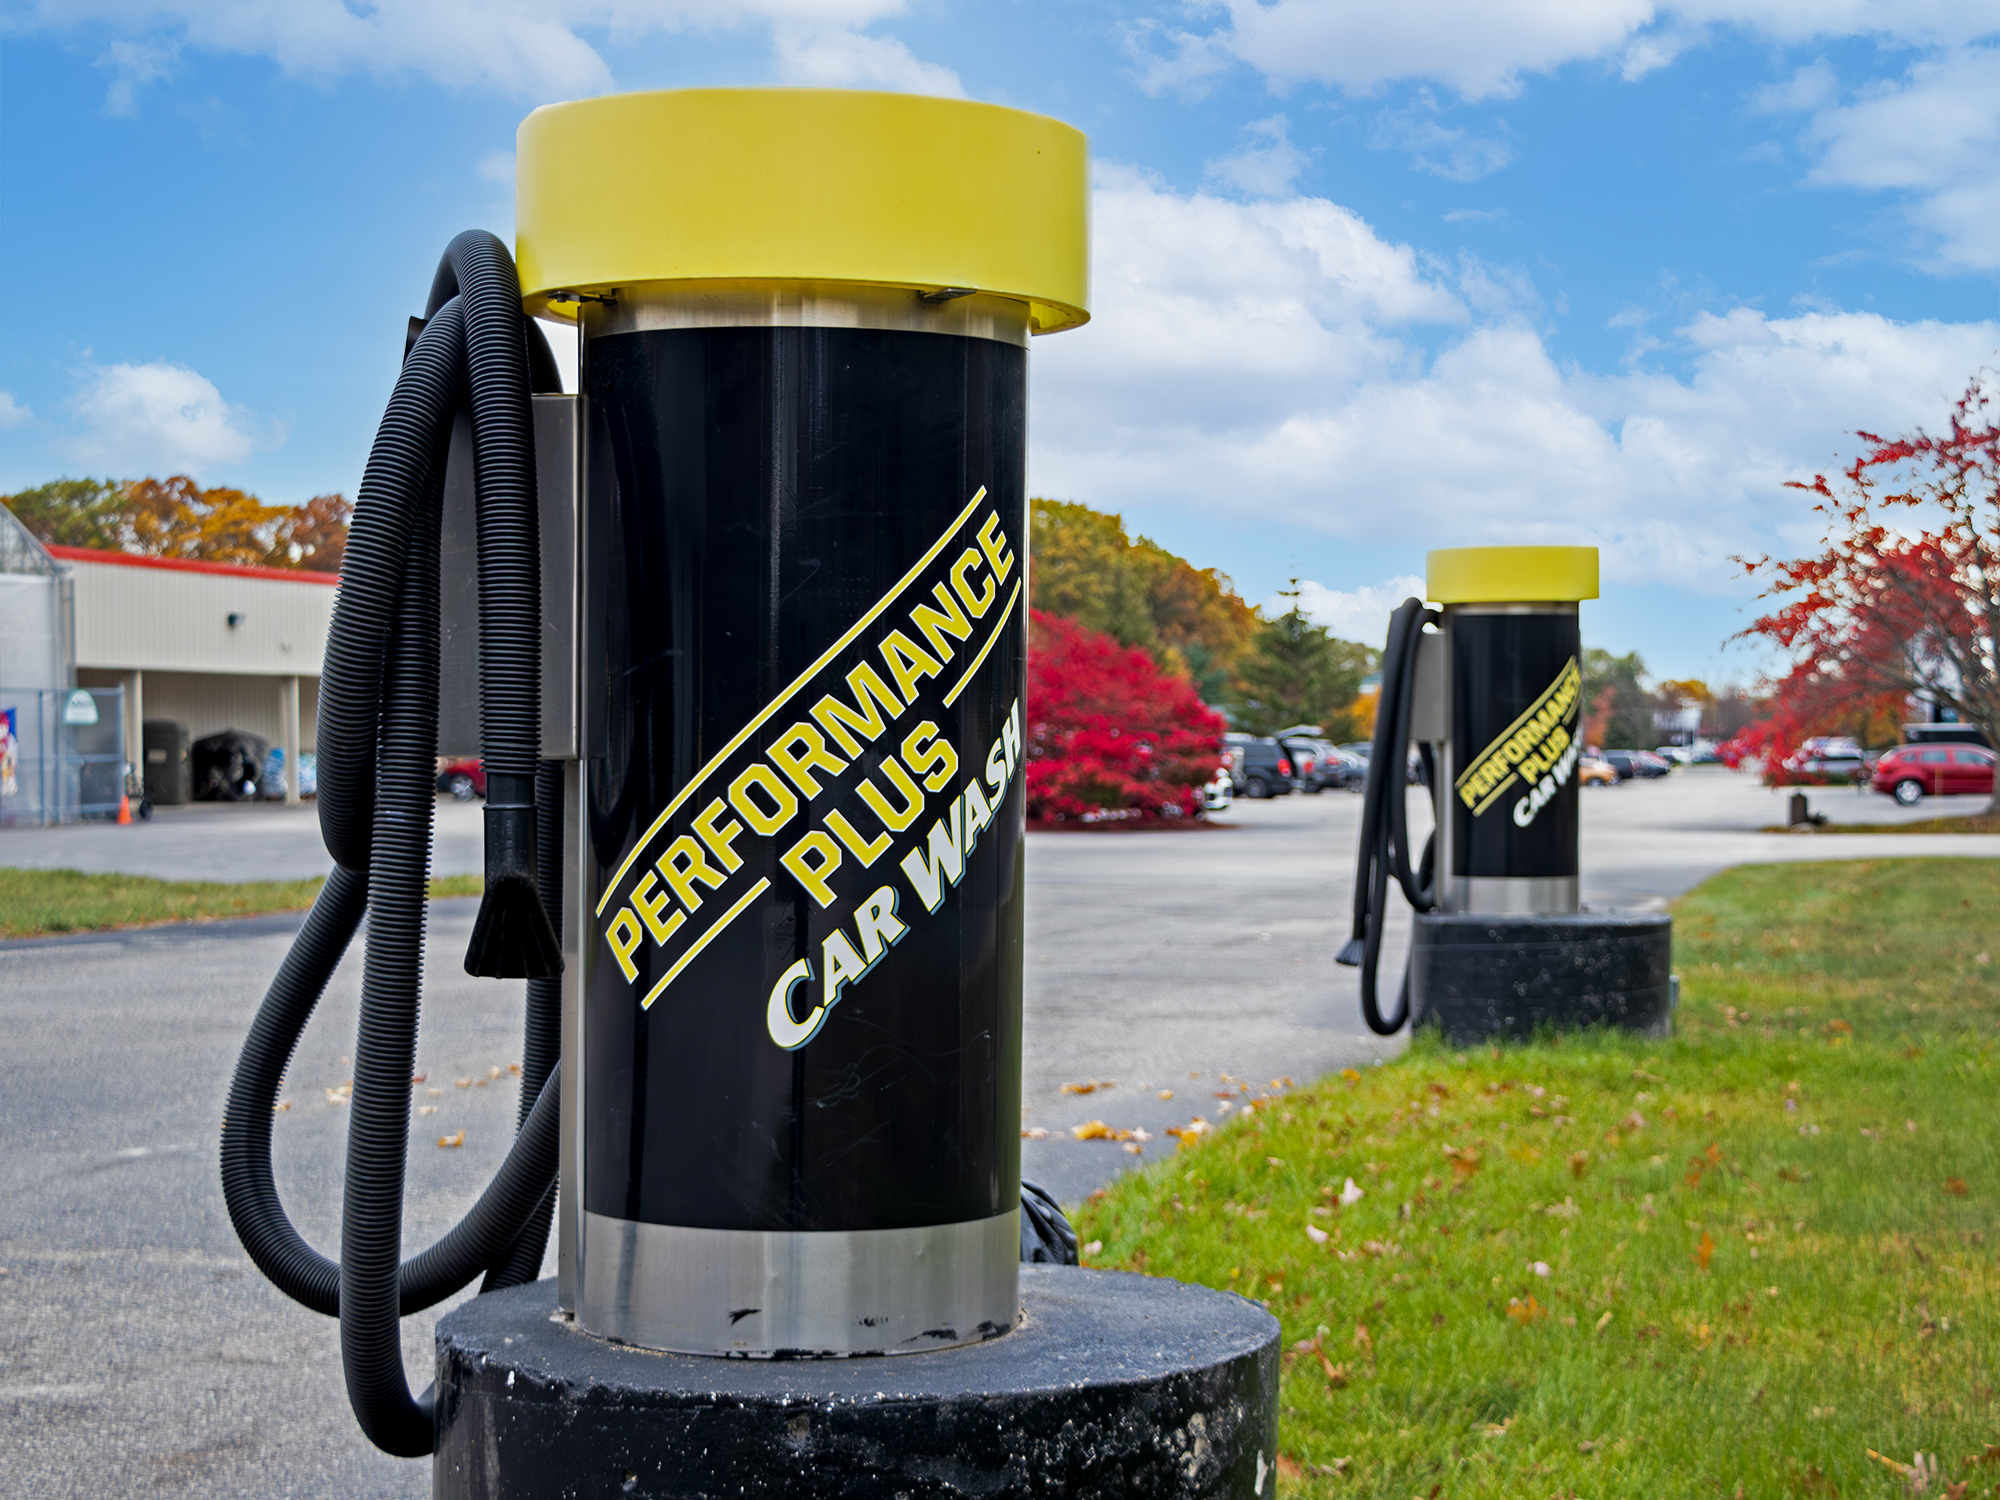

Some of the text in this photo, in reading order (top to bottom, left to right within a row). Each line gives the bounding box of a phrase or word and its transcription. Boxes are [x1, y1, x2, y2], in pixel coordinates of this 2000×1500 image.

[605, 509, 1014, 984] PERFORMANCE
[780, 720, 958, 909] PLUS
[1513, 774, 1558, 827] CAR
[1518, 726, 1570, 785] PLUS
[766, 697, 1022, 1051] CAR WASH
